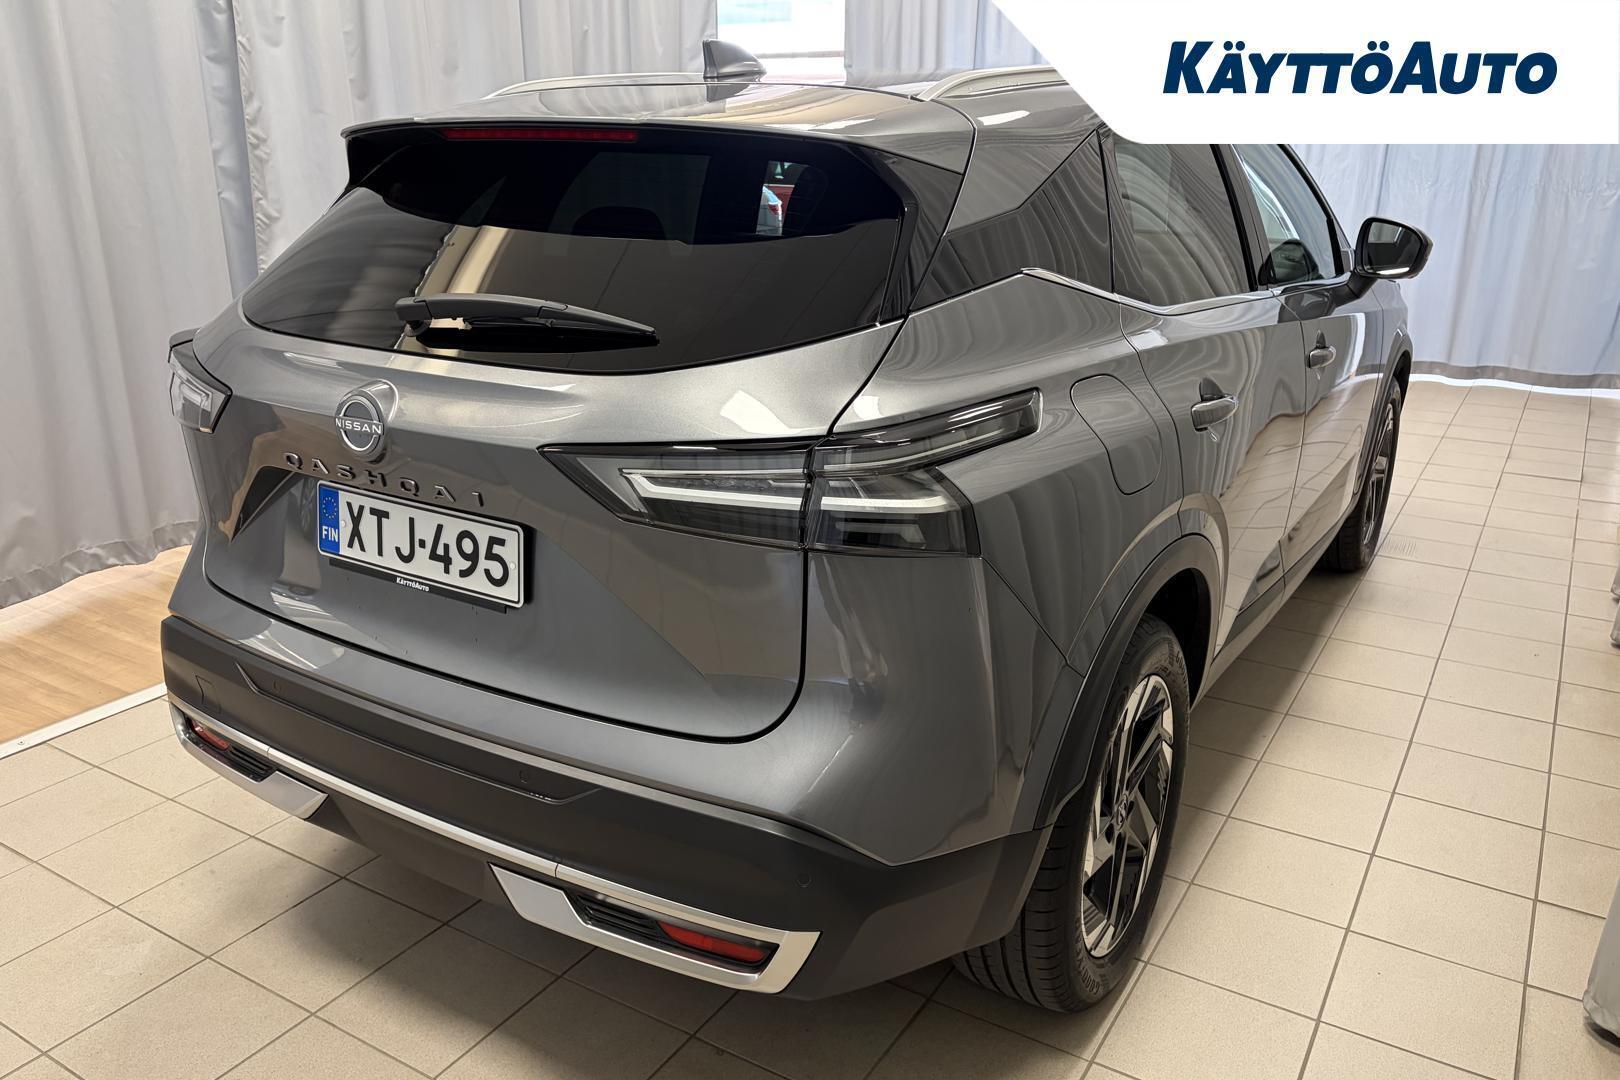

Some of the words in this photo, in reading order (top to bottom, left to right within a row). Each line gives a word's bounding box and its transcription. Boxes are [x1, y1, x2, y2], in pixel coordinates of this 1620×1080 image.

[335, 417, 382, 434] NISSAN
[285, 452, 485, 507] QASHQAI
[322, 525, 339, 543] FIN
[346, 501, 510, 587] XTJ-495
